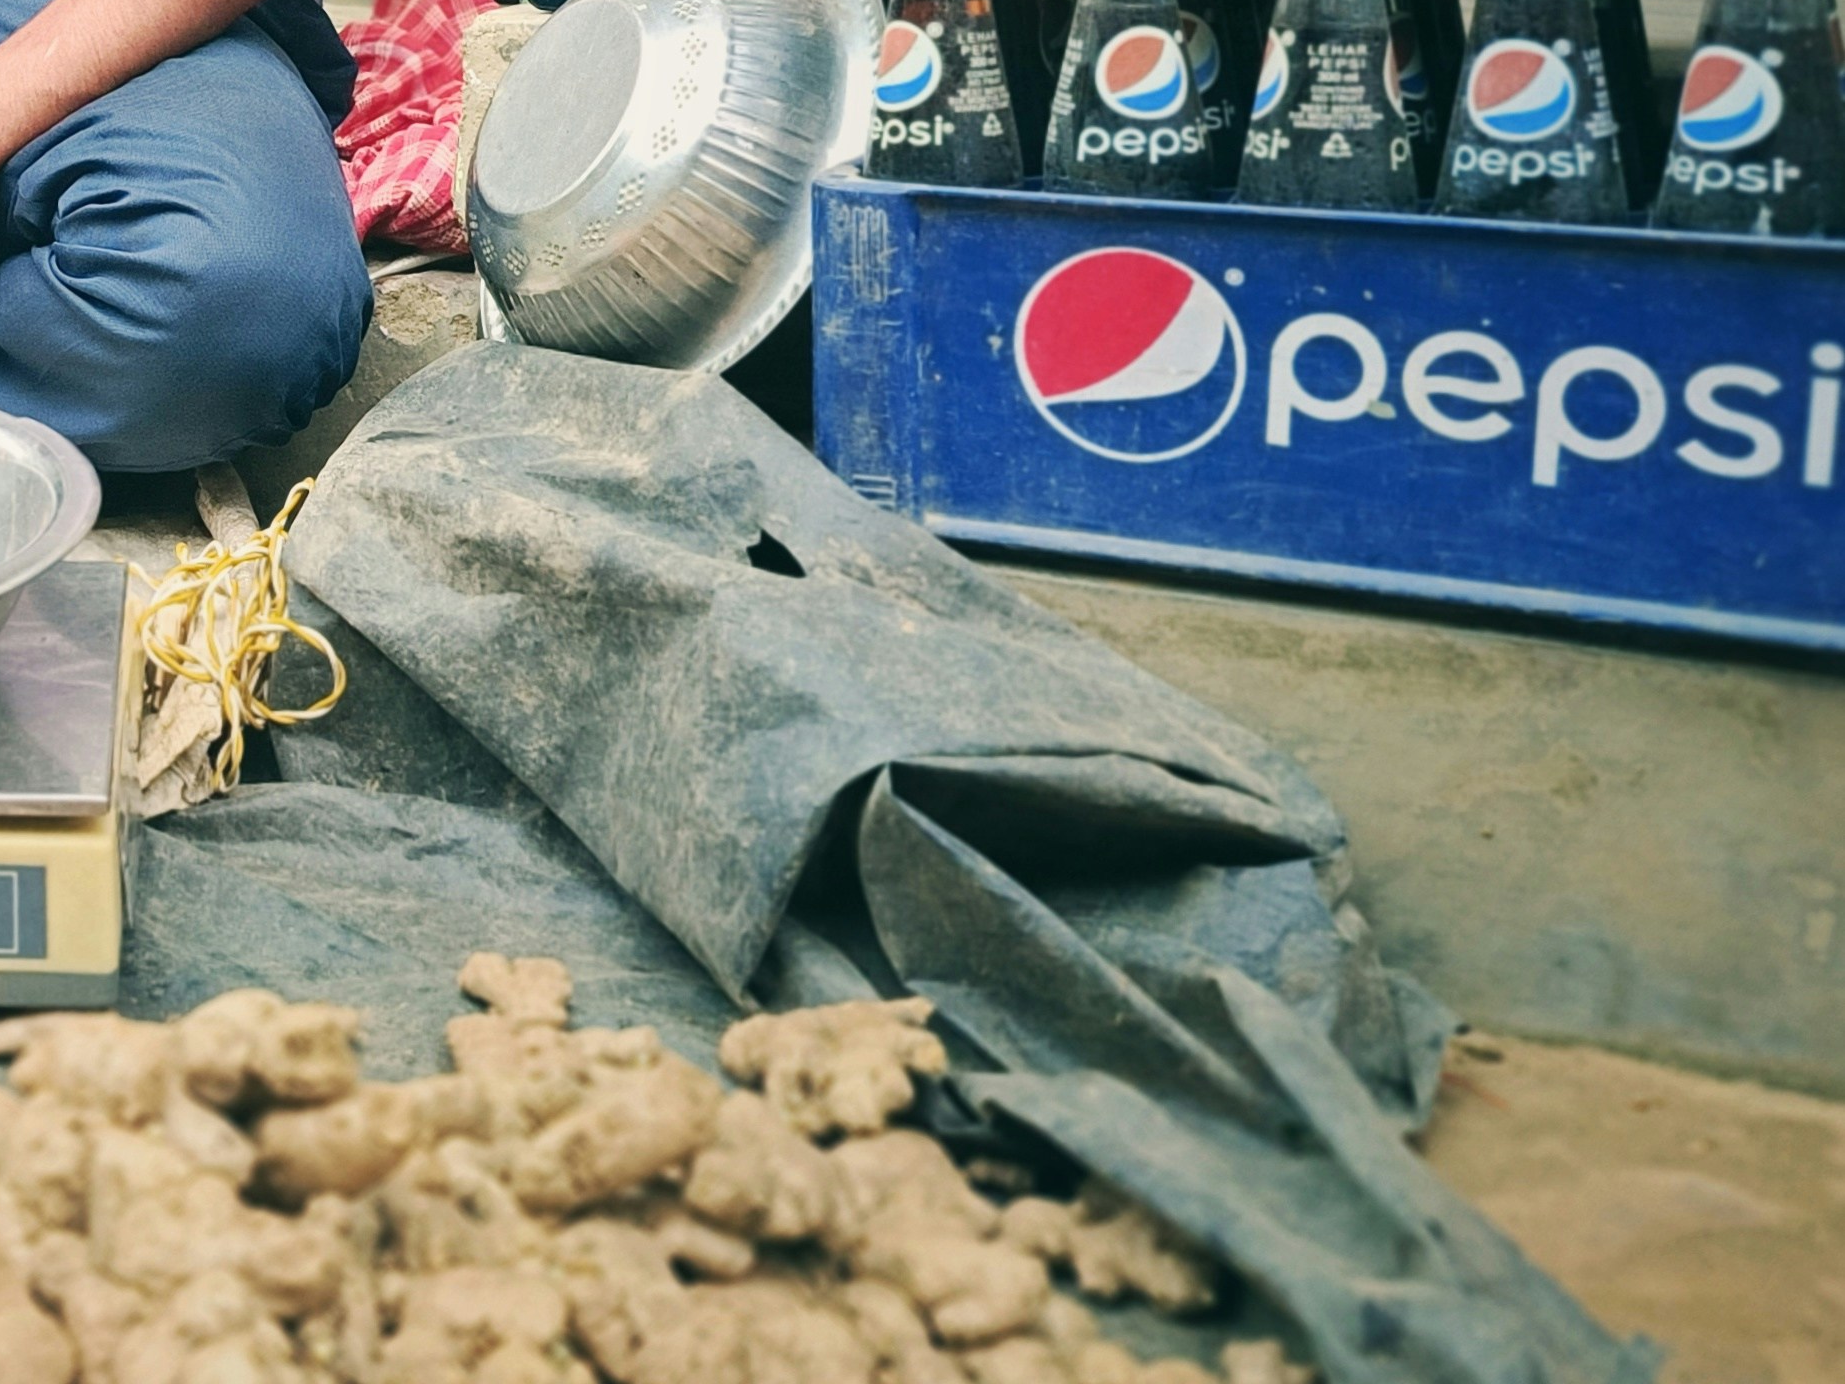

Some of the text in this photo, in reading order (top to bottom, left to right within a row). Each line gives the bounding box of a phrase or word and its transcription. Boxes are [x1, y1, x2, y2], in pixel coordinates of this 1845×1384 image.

[1076, 118, 1205, 164] pepsi
[1452, 143, 1586, 185] pepsi
[1265, 311, 1843, 490] pepsi
